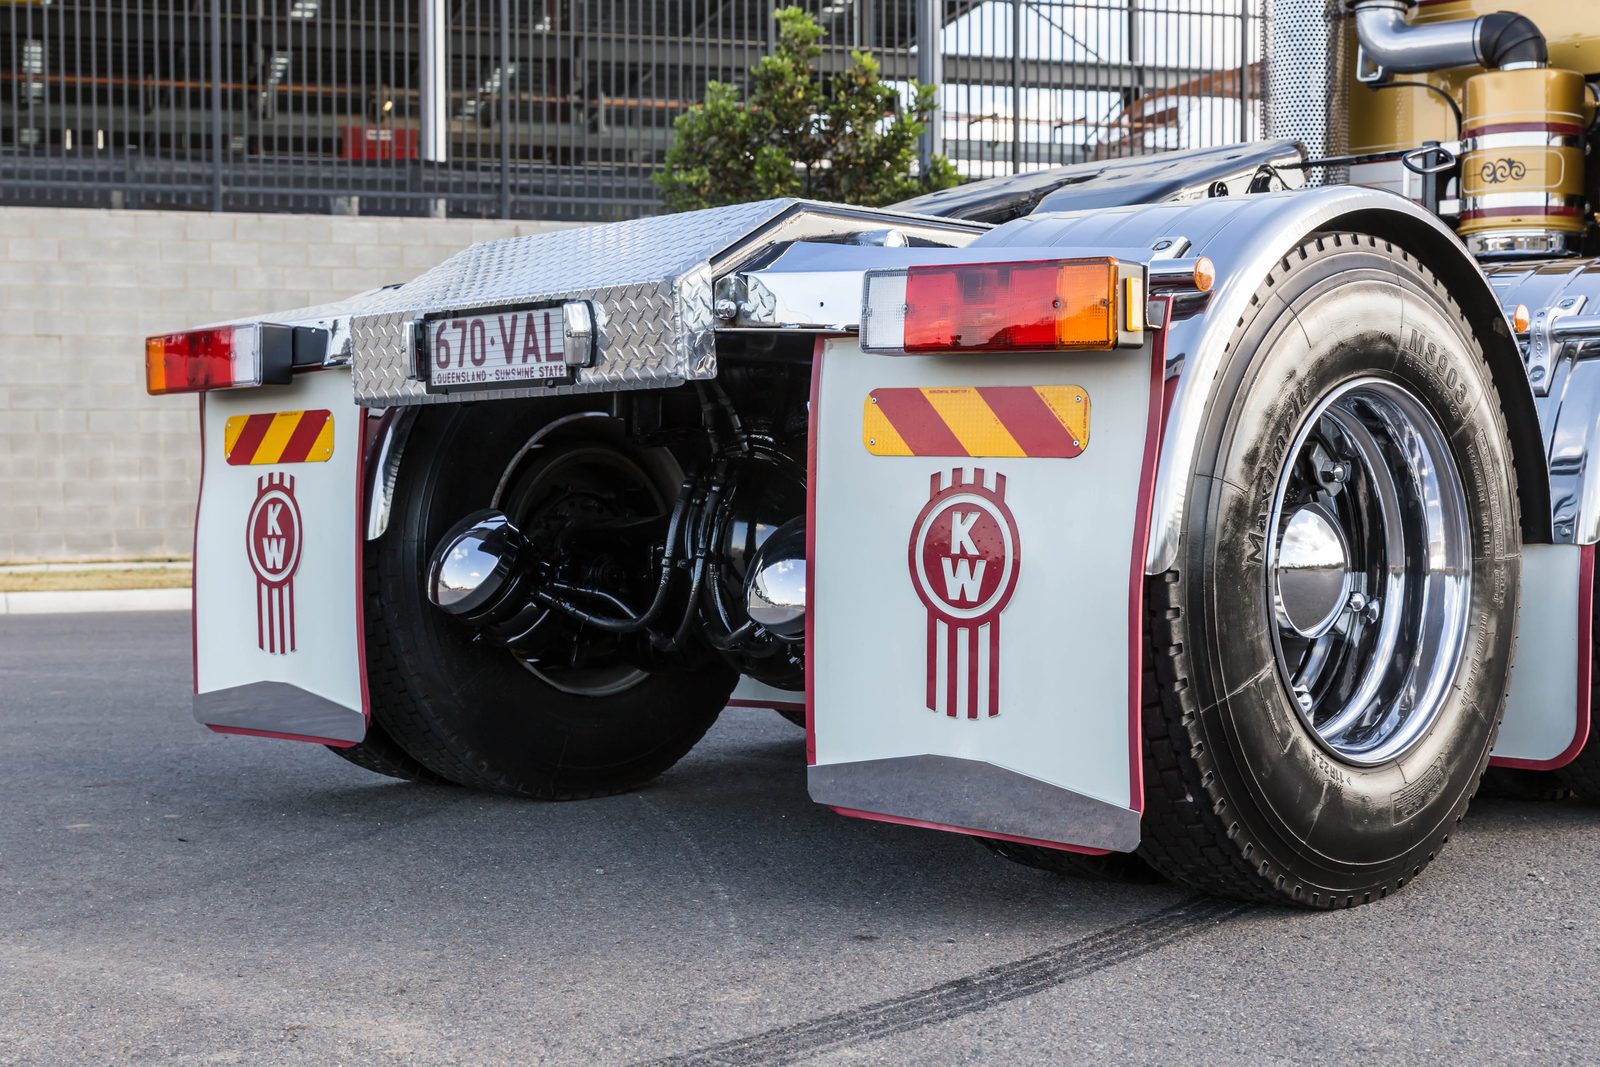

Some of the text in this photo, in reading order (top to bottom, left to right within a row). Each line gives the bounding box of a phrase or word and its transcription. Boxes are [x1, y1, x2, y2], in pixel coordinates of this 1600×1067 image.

[436, 370, 487, 384] QUEENSLAND
[495, 366, 535, 381] SUNSHINE
[538, 364, 564, 378] STATE
[1409, 328, 1468, 406] MS903
[1311, 749, 1345, 784] 11R22.5
